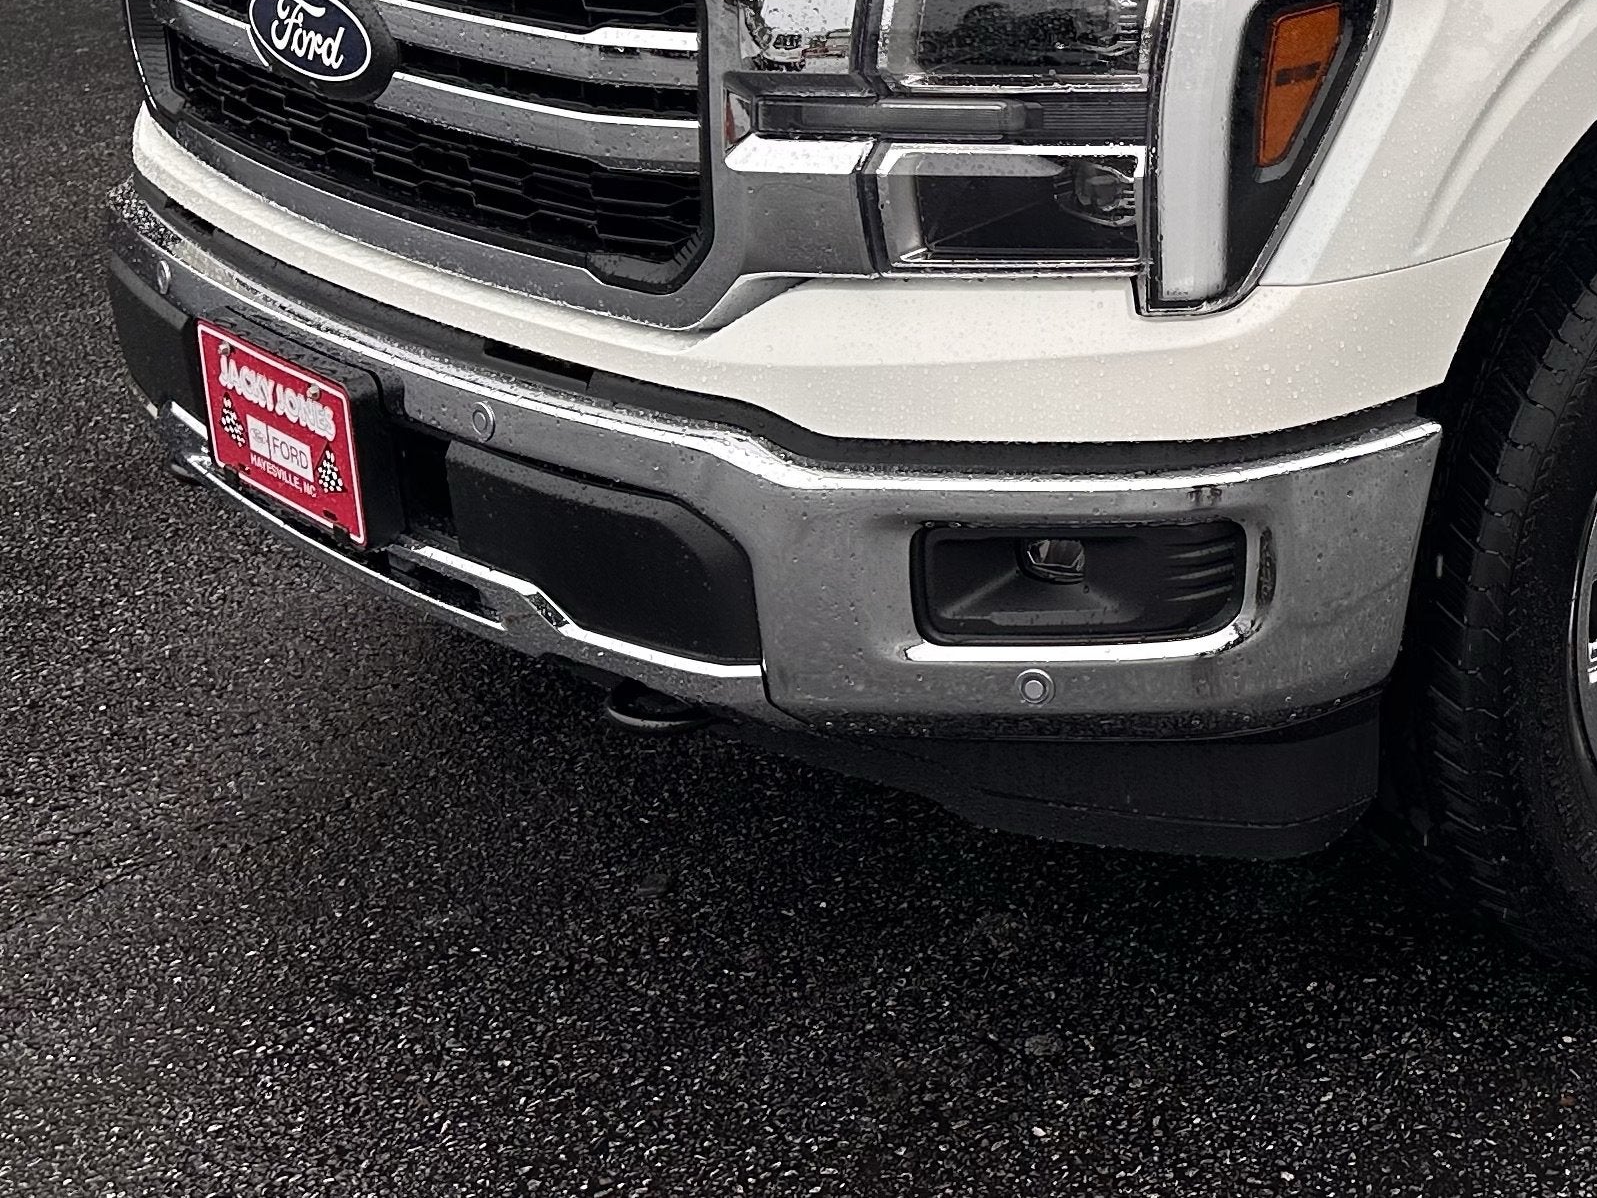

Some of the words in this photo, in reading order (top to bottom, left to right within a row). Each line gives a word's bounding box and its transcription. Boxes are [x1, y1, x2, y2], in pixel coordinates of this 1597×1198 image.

[219, 354, 275, 412] JACKY
[275, 383, 336, 442] JONES
[249, 452, 303, 494] HAYESVILLE,
[302, 481, 317, 498] NC
[271, 435, 309, 470] FORD
